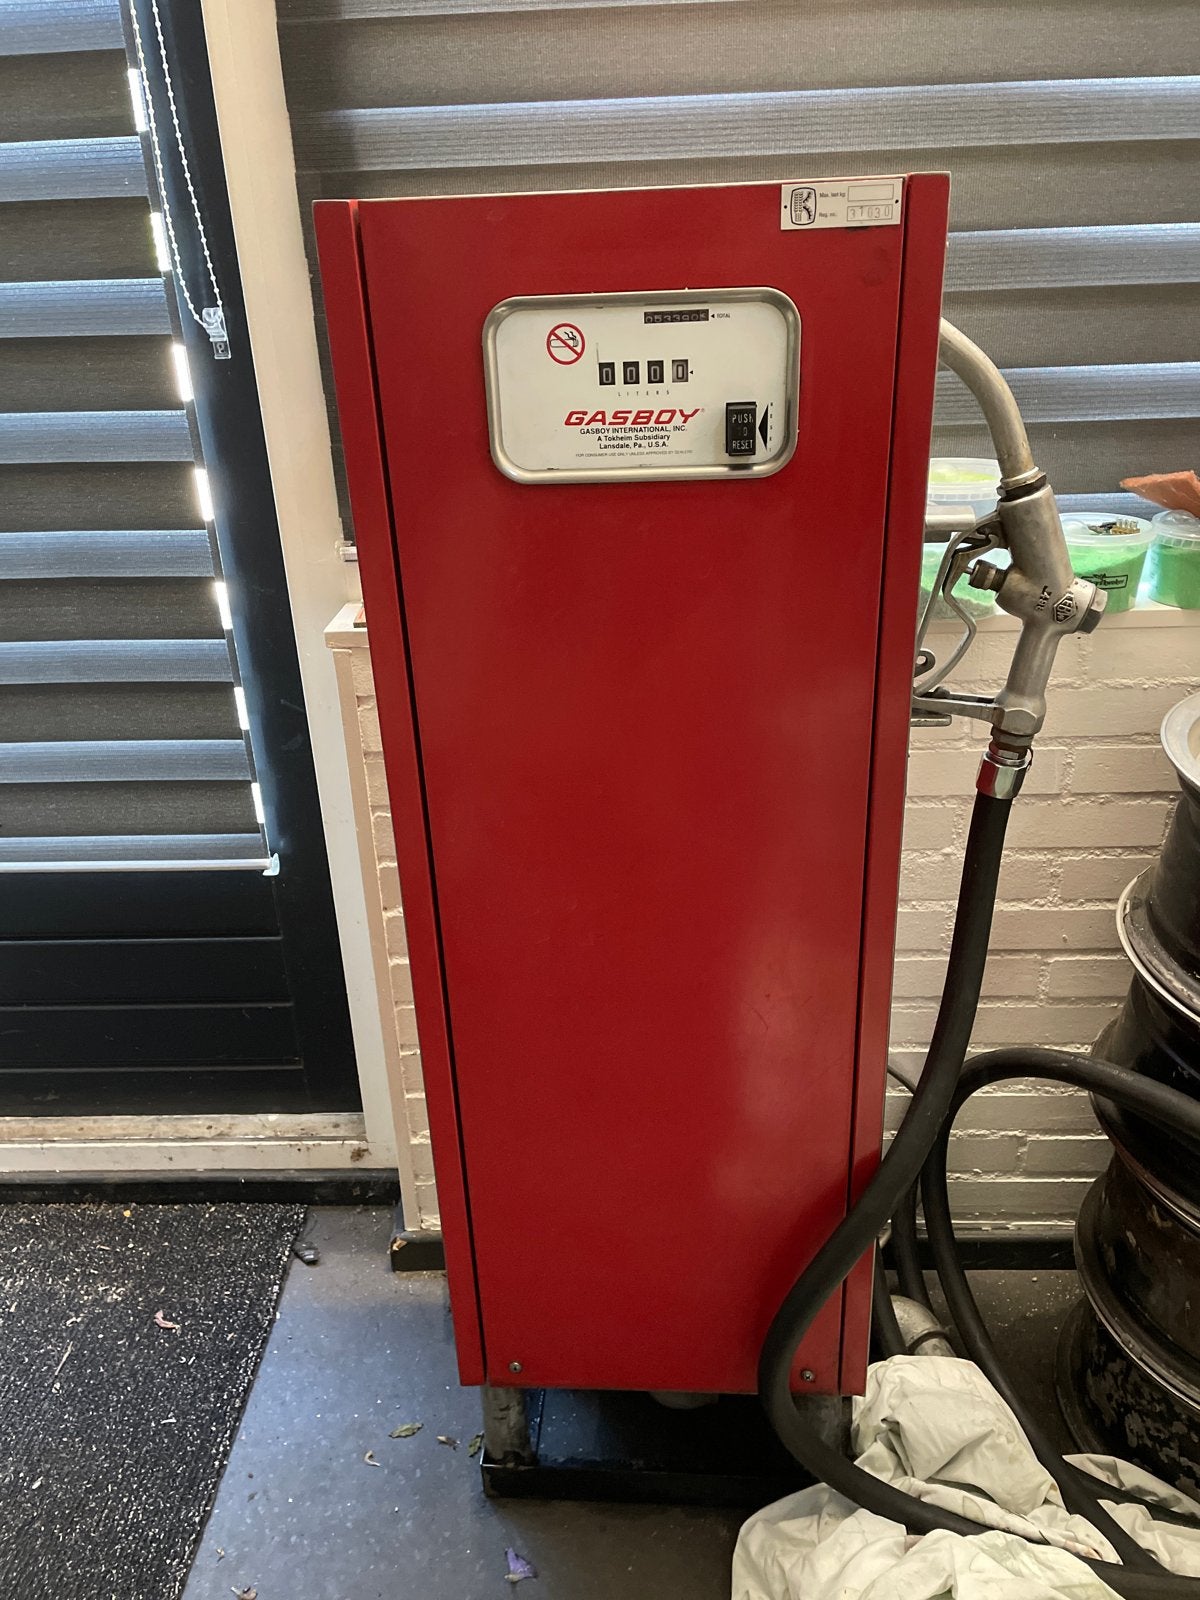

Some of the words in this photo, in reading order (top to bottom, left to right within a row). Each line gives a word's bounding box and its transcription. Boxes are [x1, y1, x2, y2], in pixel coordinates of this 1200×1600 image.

[564, 408, 700, 426] GASBOY
[732, 413, 754, 424] PUSH
[612, 426, 671, 434] INTERNATIONAL,
[634, 434, 671, 442] Subsidiary
[732, 440, 754, 450] RESET
